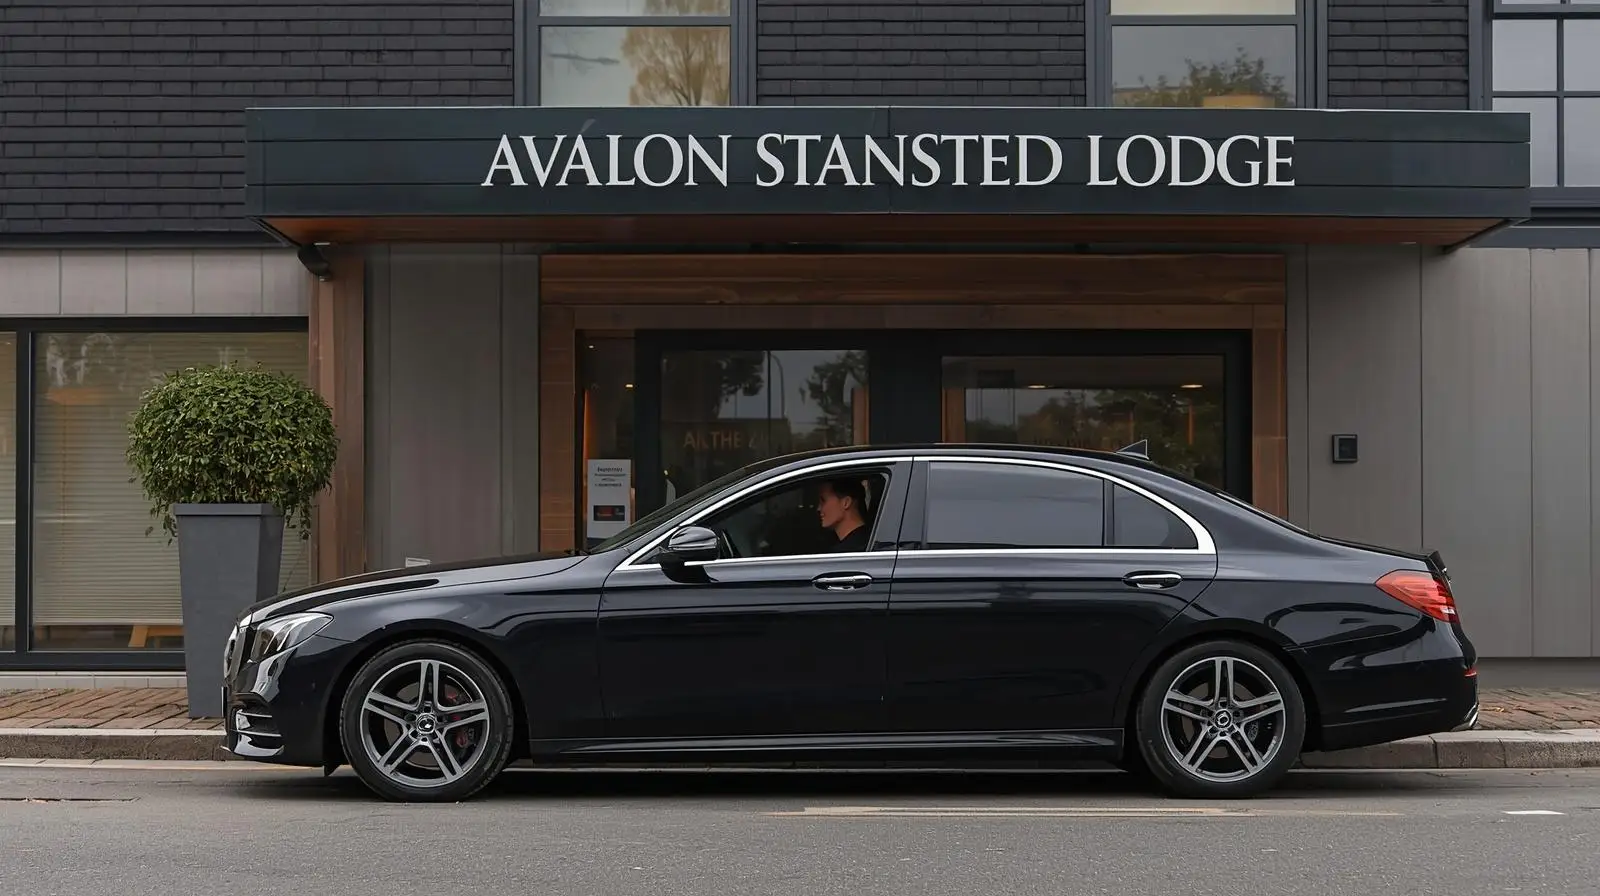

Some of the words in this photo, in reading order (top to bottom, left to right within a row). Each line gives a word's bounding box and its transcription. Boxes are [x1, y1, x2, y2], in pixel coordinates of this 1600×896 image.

[481, 134, 731, 187] AVALON
[756, 134, 1063, 187] STANSTED
[1087, 134, 1295, 187] LODGE
